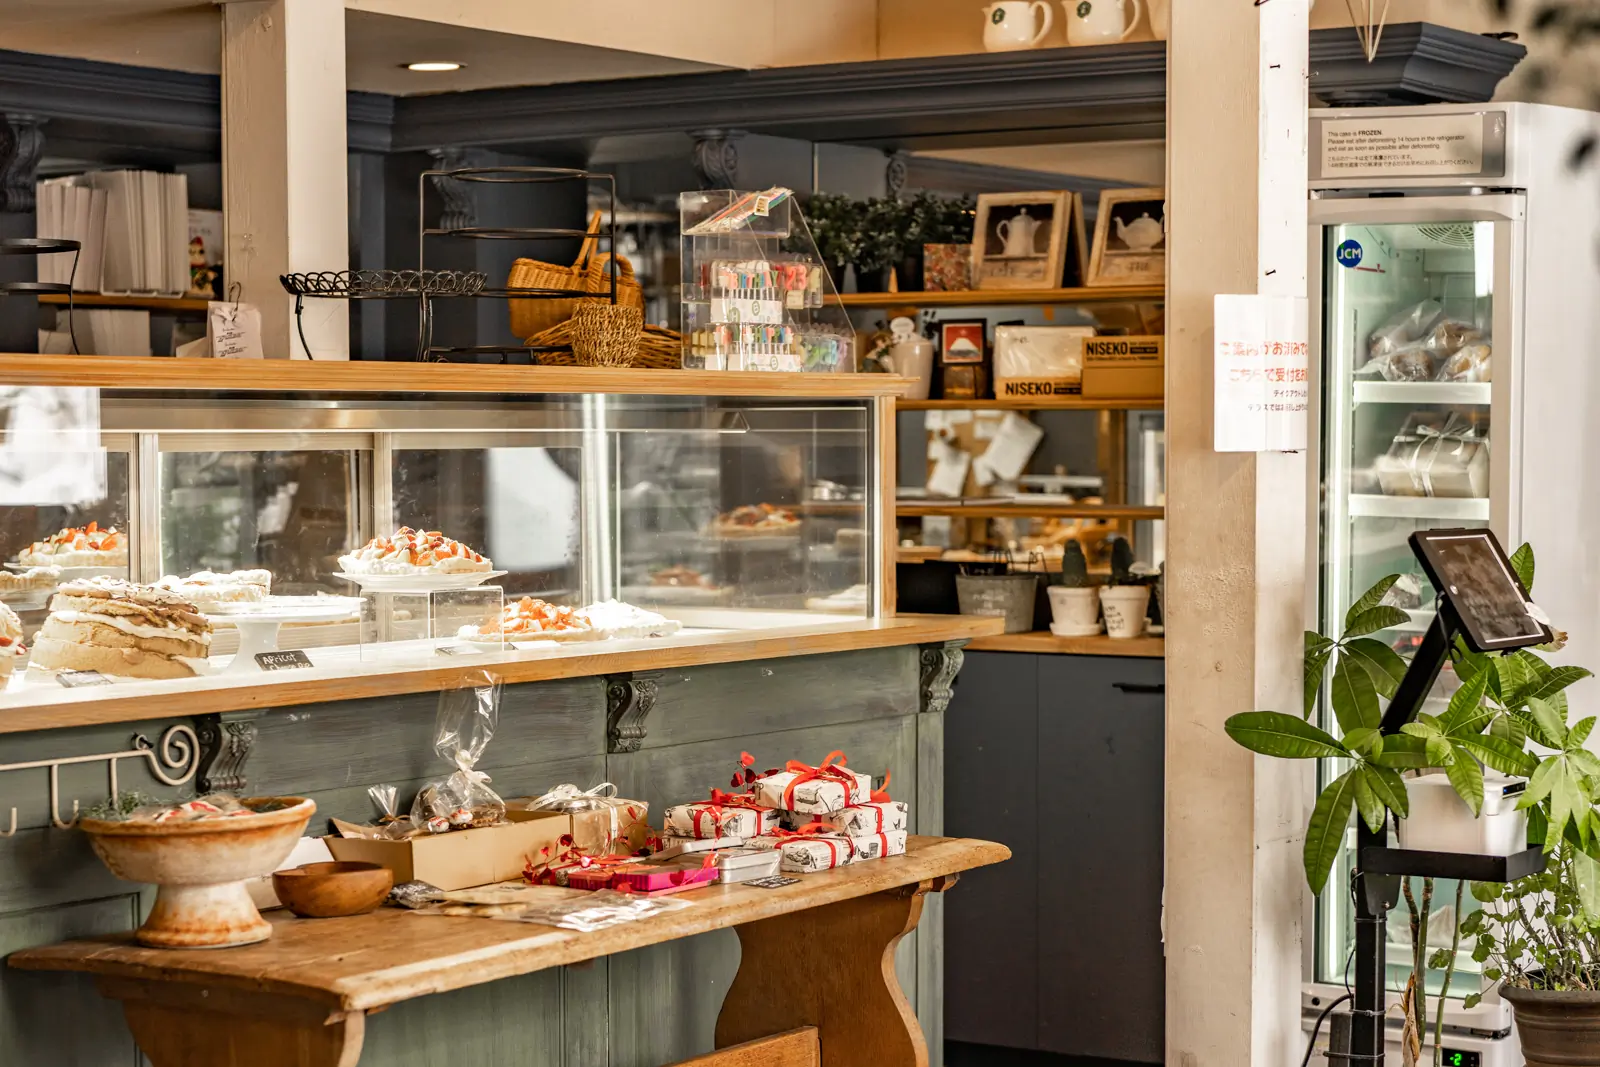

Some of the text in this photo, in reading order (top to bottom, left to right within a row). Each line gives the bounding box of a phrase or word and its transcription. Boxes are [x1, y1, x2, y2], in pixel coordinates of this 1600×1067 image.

[1338, 248, 1362, 260] JCM
[1086, 341, 1128, 356] NISEKO
[1005, 382, 1053, 396] NISEKO
[1449, 1053, 1462, 1066] -2
